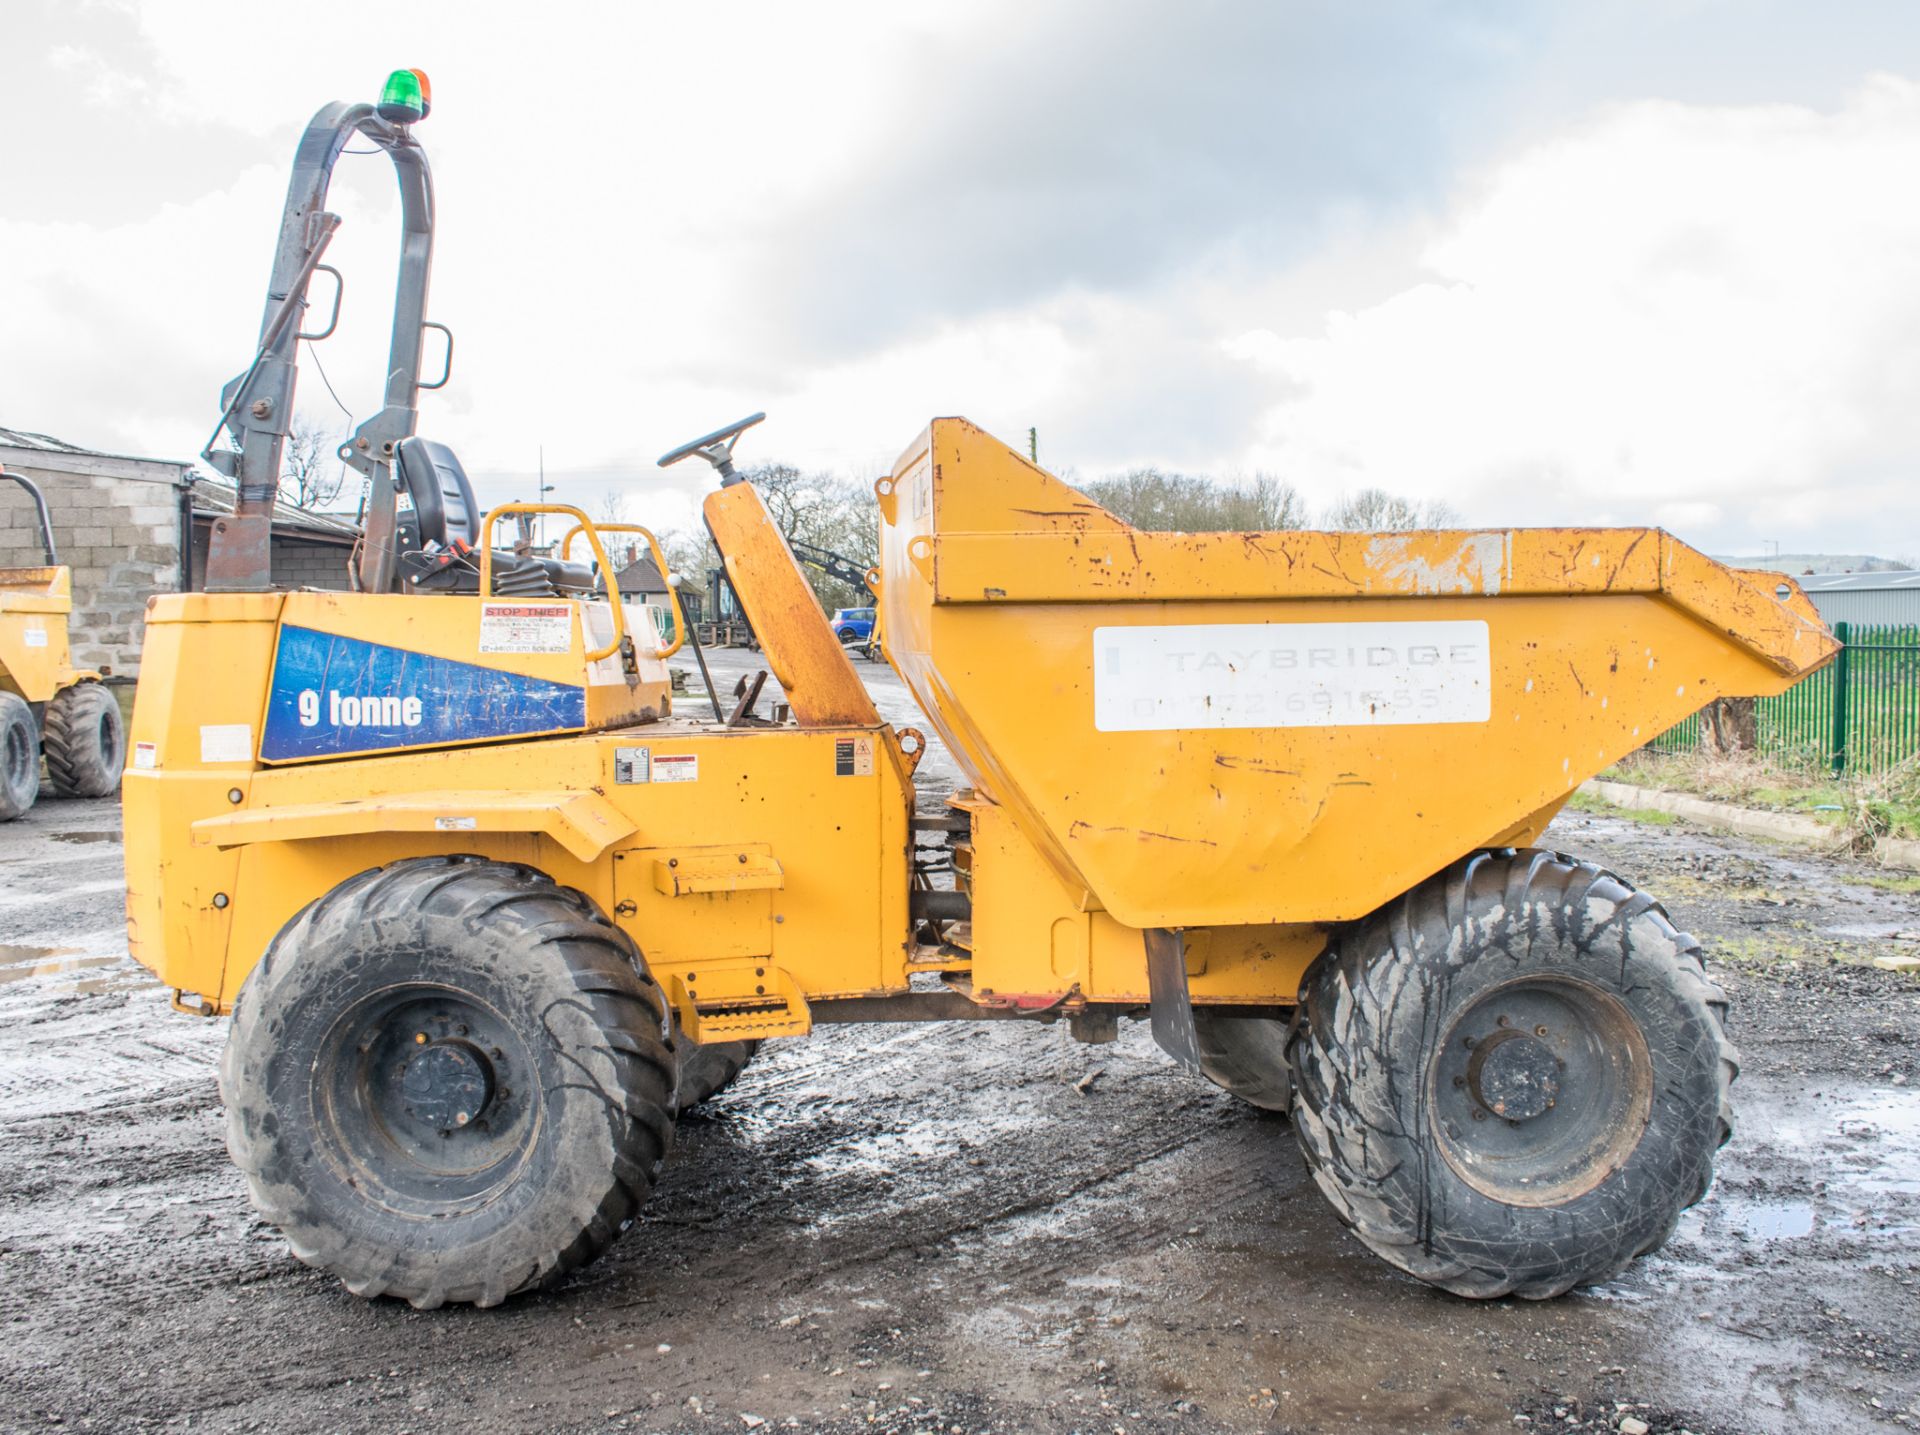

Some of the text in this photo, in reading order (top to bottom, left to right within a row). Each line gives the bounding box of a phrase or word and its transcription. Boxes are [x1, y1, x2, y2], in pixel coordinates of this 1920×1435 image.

[486, 608, 569, 616] STOP THIEF!
[1166, 644, 1479, 673] TAYBRIDGE
[298, 689, 422, 727] 9 tonne
